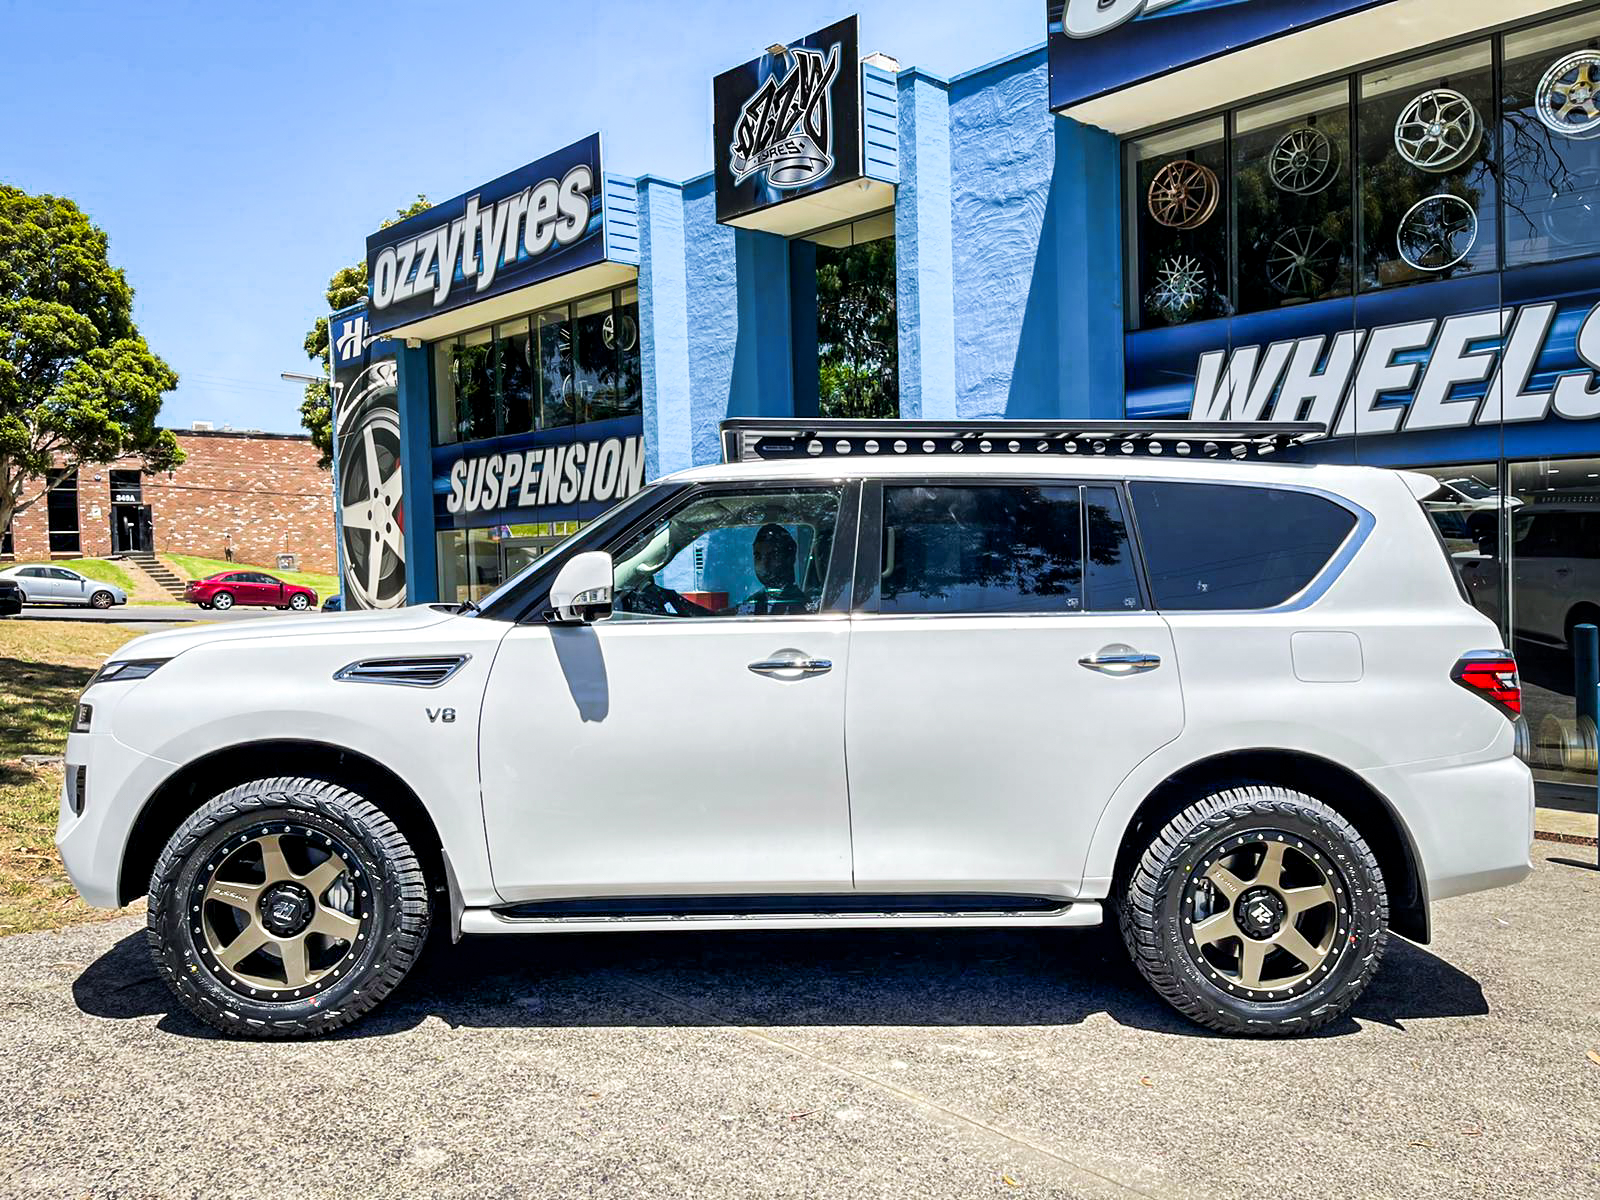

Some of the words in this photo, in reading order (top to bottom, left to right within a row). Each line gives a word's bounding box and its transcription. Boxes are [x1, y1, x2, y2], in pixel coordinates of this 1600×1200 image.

[757, 141, 801, 162] TYRES
[373, 164, 593, 310] ozzytyres
[447, 436, 643, 513] SUSPENSION
[425, 707, 456, 723] V8
